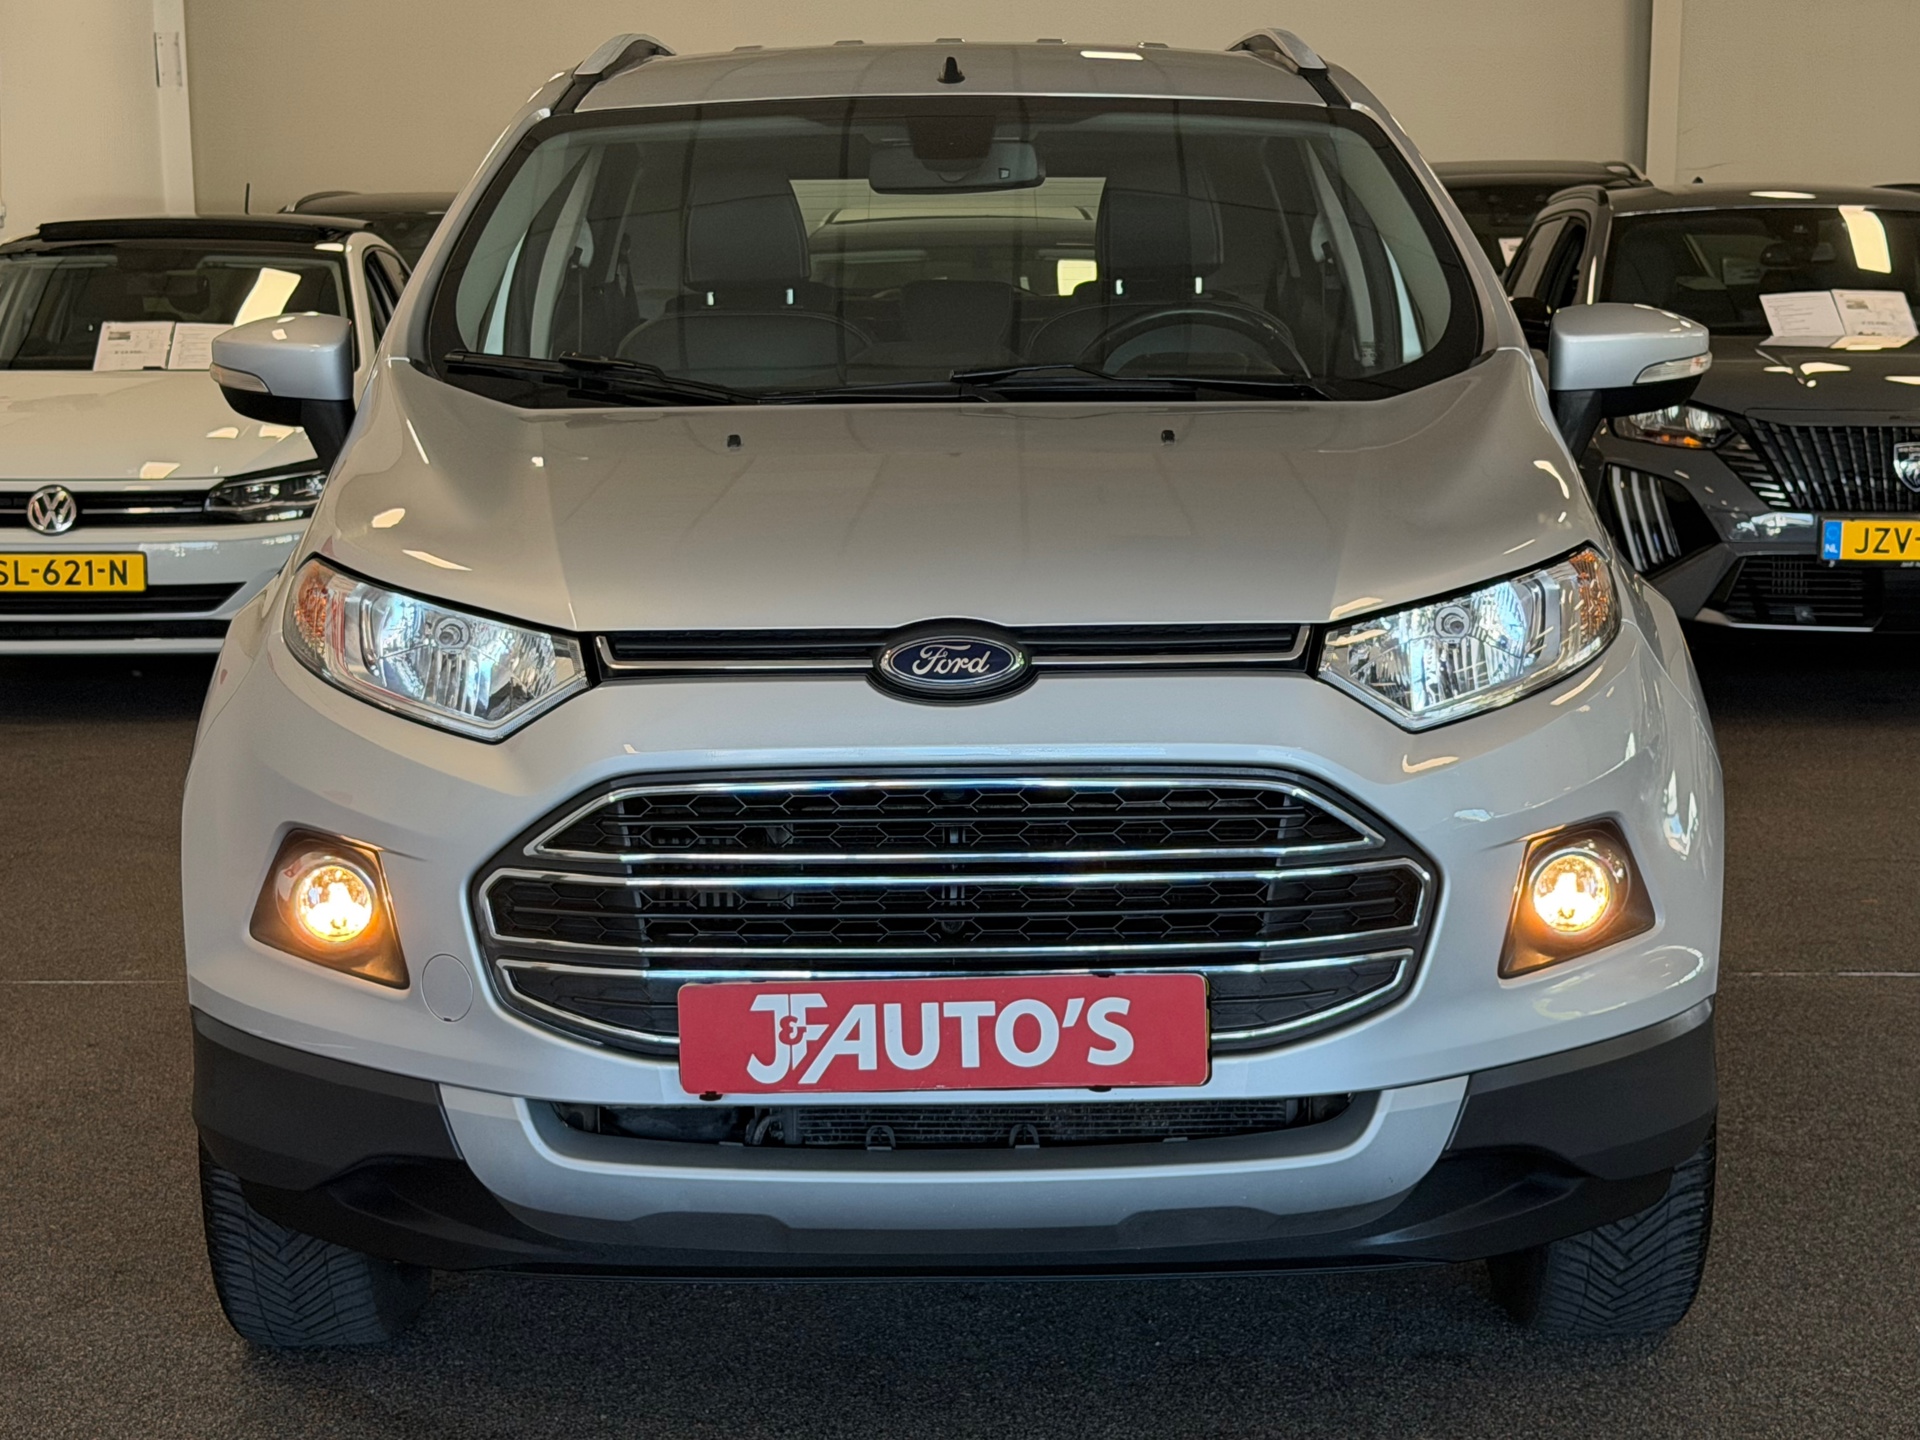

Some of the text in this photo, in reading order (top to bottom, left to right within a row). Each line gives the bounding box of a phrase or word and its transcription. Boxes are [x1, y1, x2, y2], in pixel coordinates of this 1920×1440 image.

[1825, 543, 1838, 553] NL
[912, 644, 991, 675] Ford
[798, 997, 1135, 1085] AUTO'S
